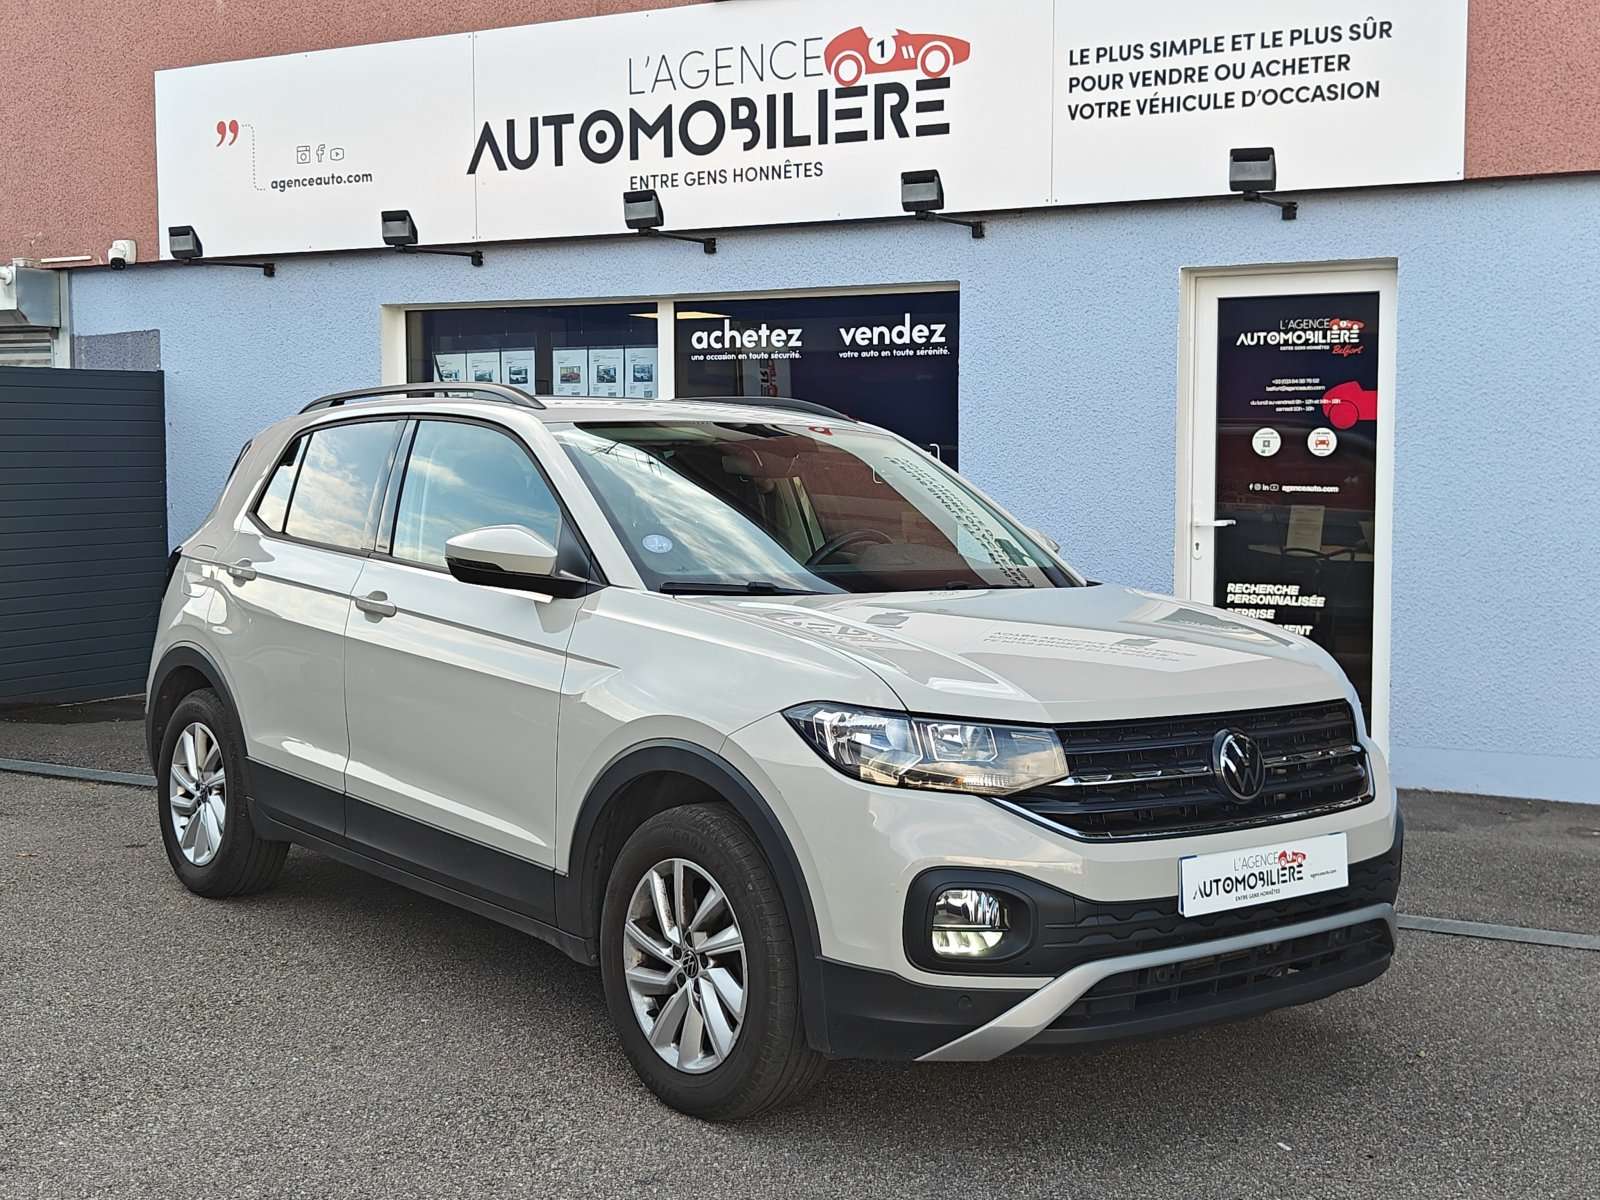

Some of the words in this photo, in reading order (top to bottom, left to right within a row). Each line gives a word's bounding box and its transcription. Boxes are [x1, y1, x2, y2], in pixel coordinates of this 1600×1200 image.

[876, 40, 885, 58] 1
[1069, 49, 1090, 66] LE
[1096, 44, 1144, 63] PLUS
[1149, 36, 1225, 59] SIMPLE
[1231, 33, 1255, 52] ET
[1260, 31, 1283, 48] LE
[1289, 25, 1343, 46] PLUS
[1349, 16, 1393, 40] SÛR
[629, 37, 823, 95] L'AGENCE
[1069, 73, 1124, 93] POUR
[1129, 66, 1209, 88] VENDRE
[1214, 63, 1246, 81] OU
[1250, 54, 1351, 79] ACHETER
[1068, 100, 1131, 121] VOTRE
[1136, 92, 1235, 115] VÉHICULE
[1241, 80, 1380, 107] D'OCCASION
[271, 173, 373, 192] agenceauto.com
[630, 173, 678, 190] ENTRE
[684, 169, 727, 186] GENS
[733, 159, 823, 184] HONNÊTES
[839, 313, 946, 346] vendez
[1280, 319, 1329, 329] L'AGENCE
[691, 319, 803, 349] achetez
[706, 352, 736, 360] occasion
[749, 352, 768, 360] toute
[770, 350, 802, 359] sécurité.
[861, 350, 879, 358] auto
[893, 348, 914, 356] toute
[916, 347, 950, 356] sérénité.
[1227, 583, 1299, 595] RECHERCHE
[1227, 594, 1325, 607] PERSONNALISÉE
[1234, 852, 1278, 871] L'AGENCE
